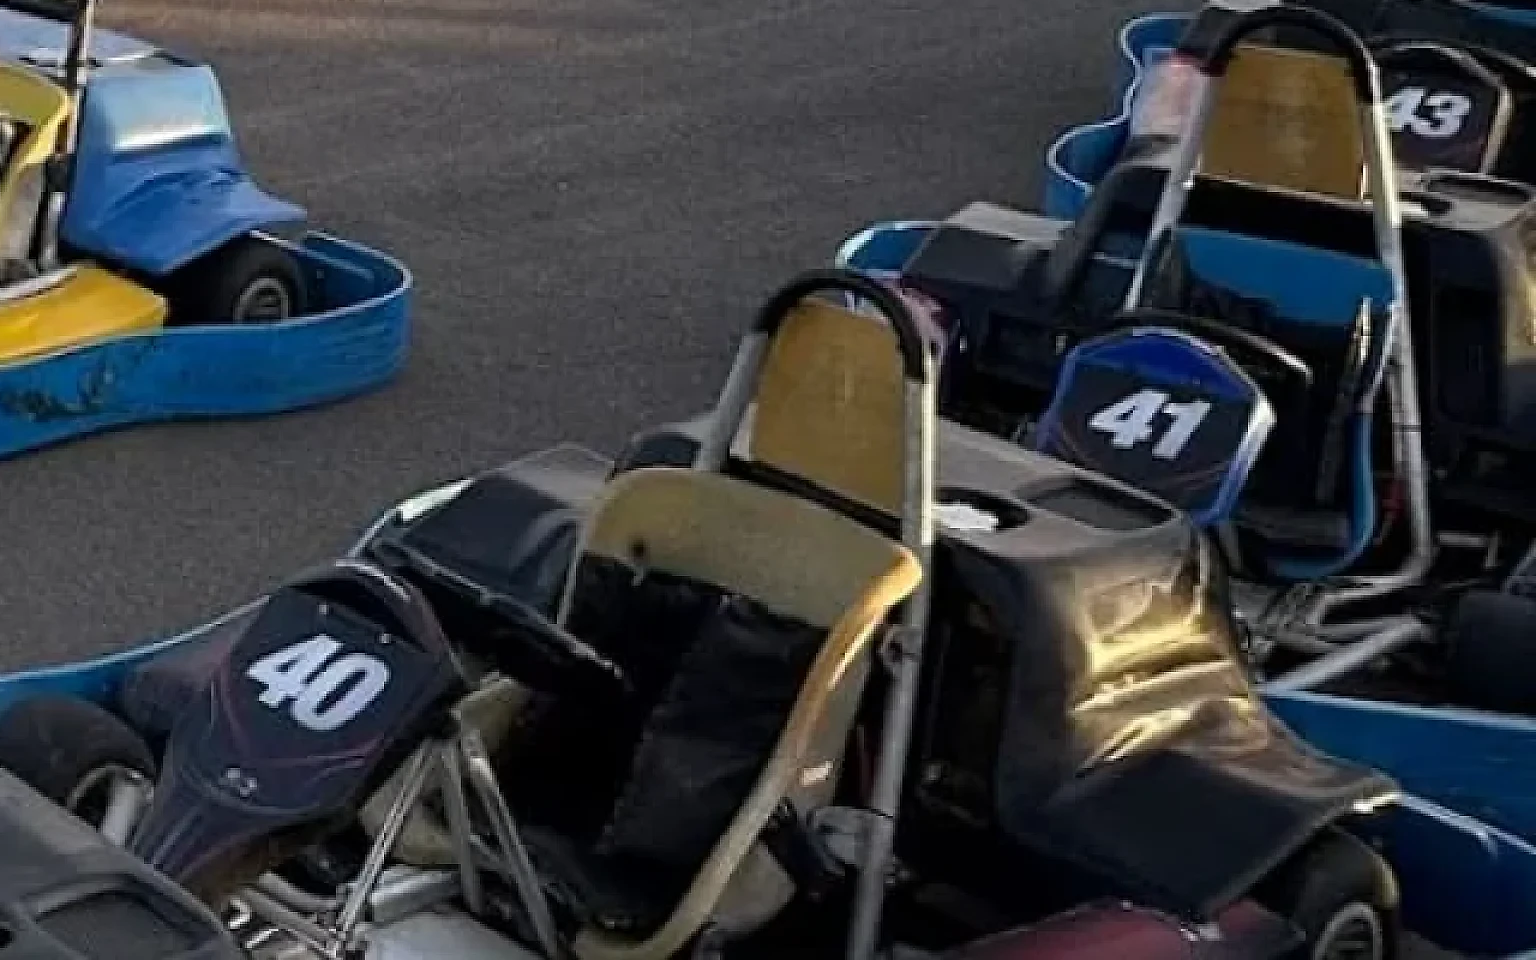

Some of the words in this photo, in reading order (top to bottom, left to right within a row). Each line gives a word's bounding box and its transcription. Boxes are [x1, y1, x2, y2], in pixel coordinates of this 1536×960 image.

[1383, 87, 1471, 138] 43
[1088, 388, 1213, 459] 41
[244, 633, 392, 732] 40
